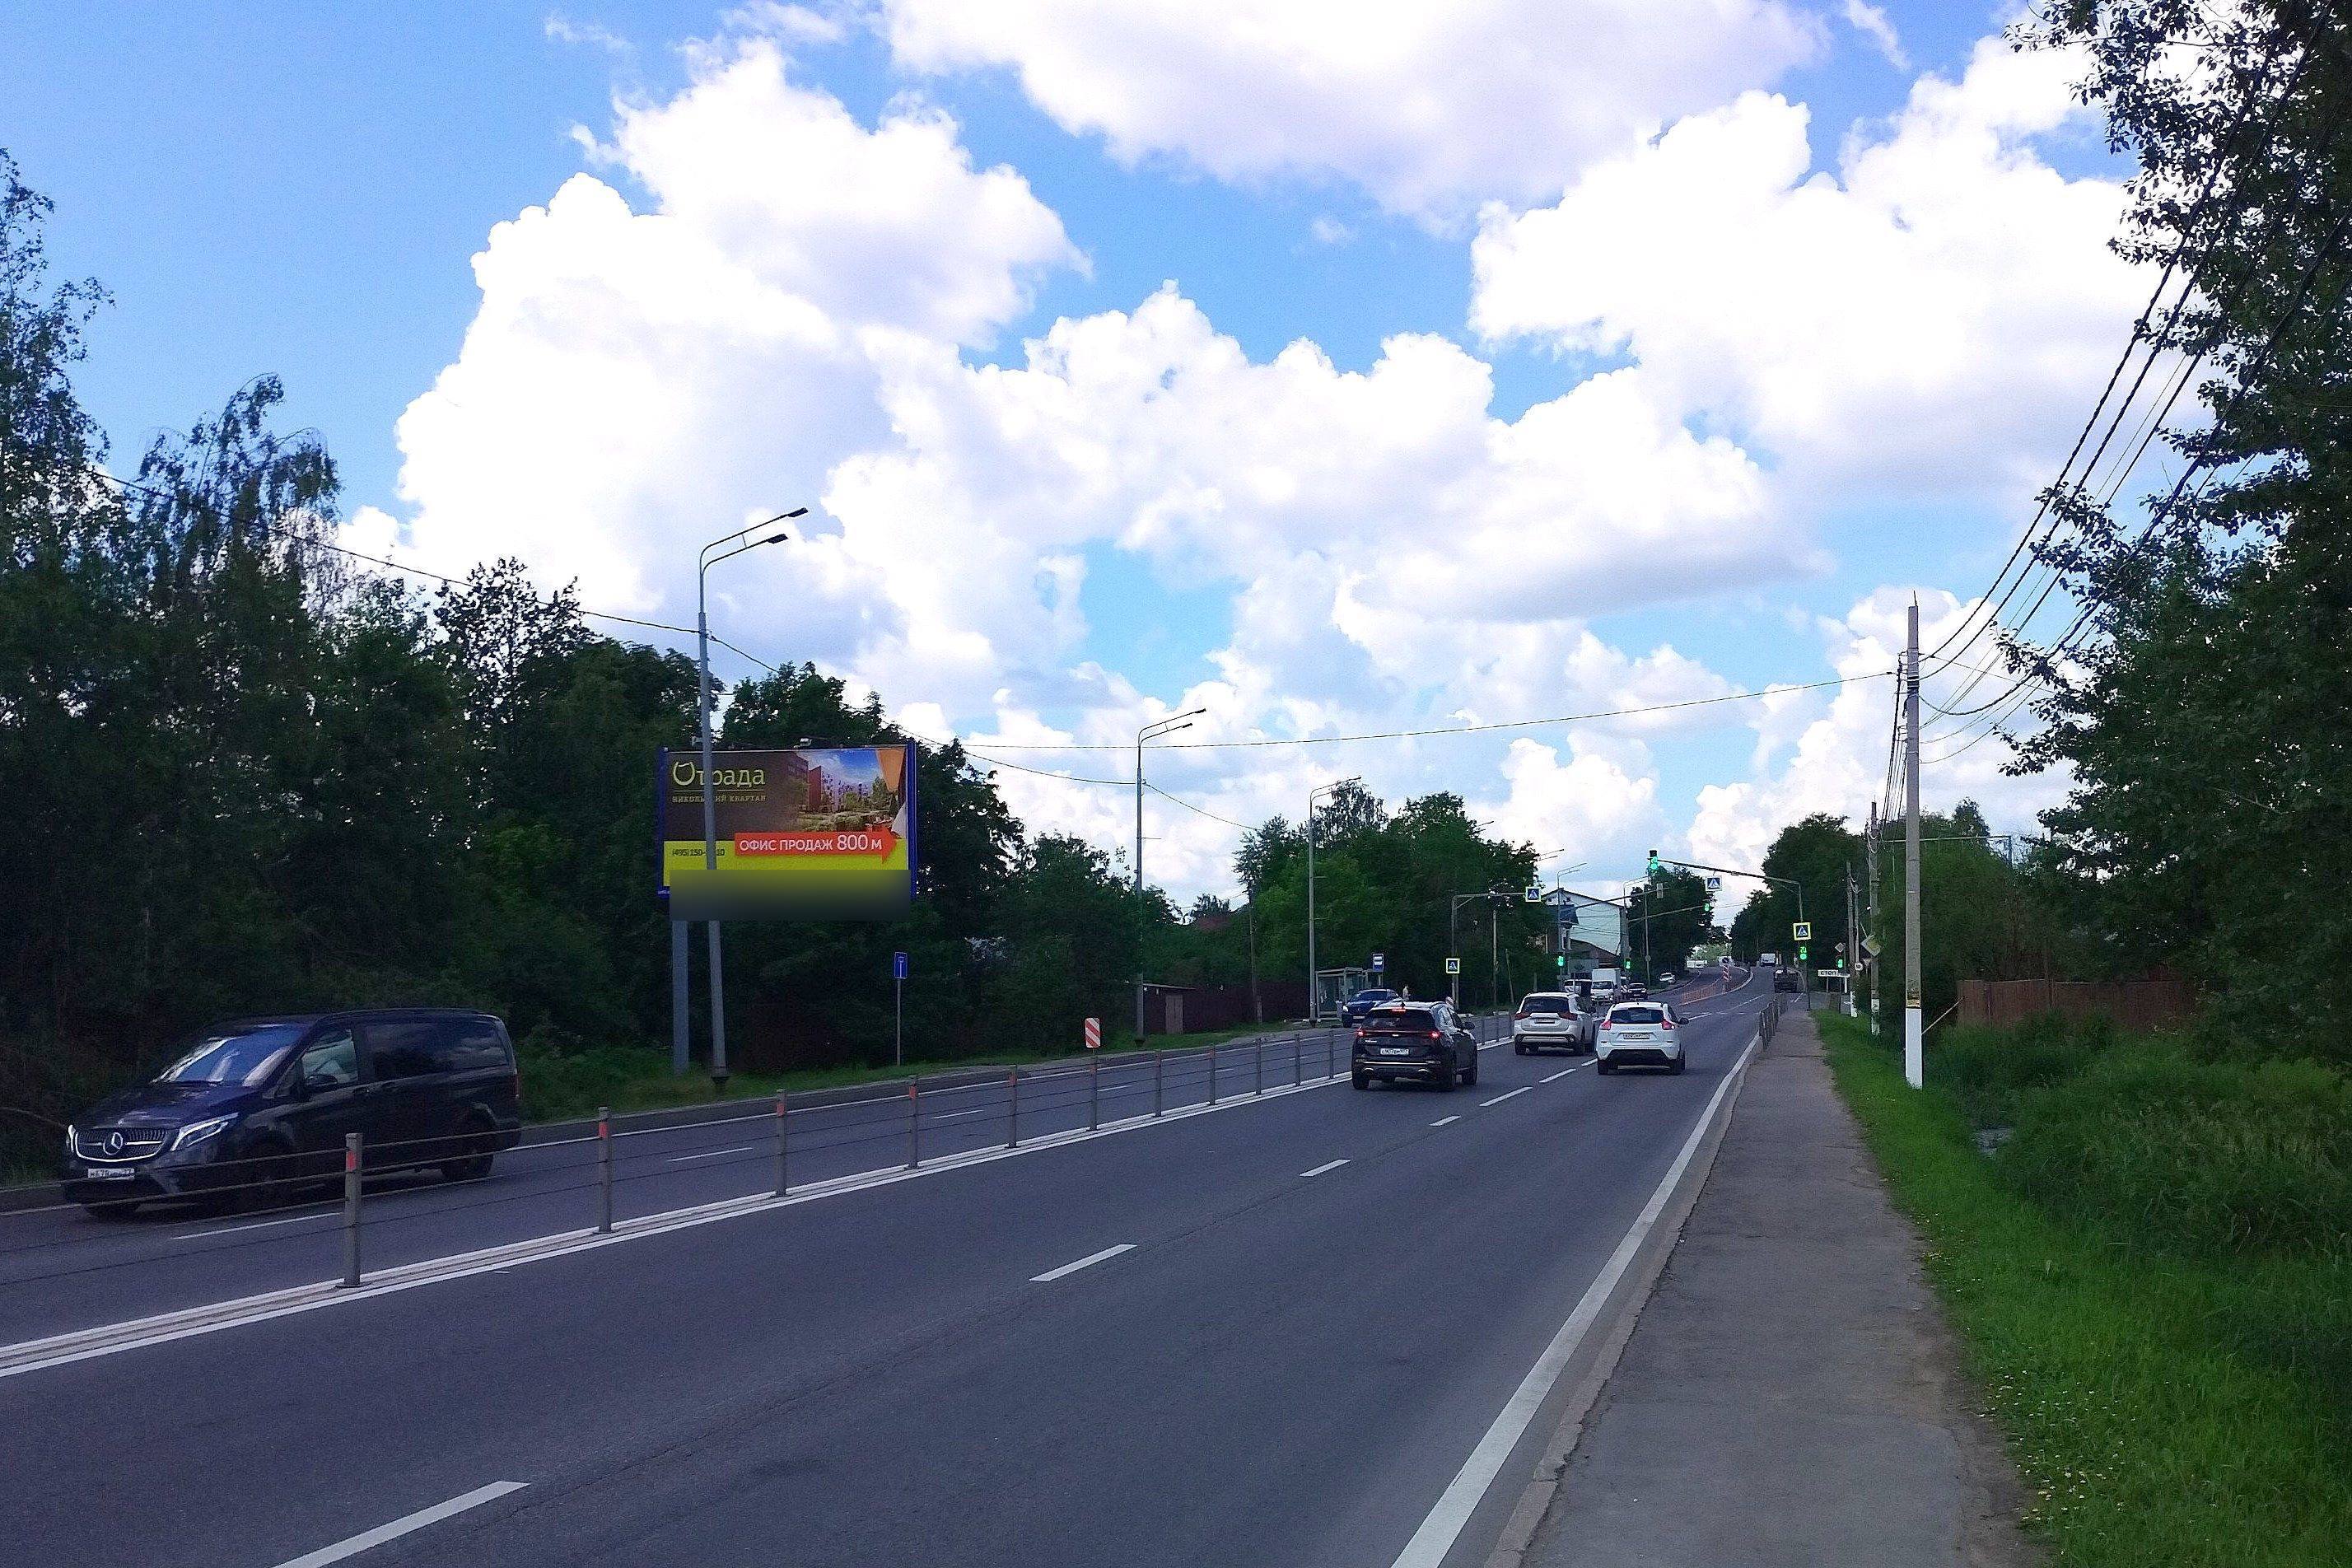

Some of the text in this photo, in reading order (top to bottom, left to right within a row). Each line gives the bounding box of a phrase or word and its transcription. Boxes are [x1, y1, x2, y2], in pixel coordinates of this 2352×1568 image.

[672, 795, 726, 804] НИКОЛЬИЙ
[739, 839, 777, 852] ОФИС
[779, 839, 833, 852] ПРОДАЖ
[837, 834, 869, 851] 800
